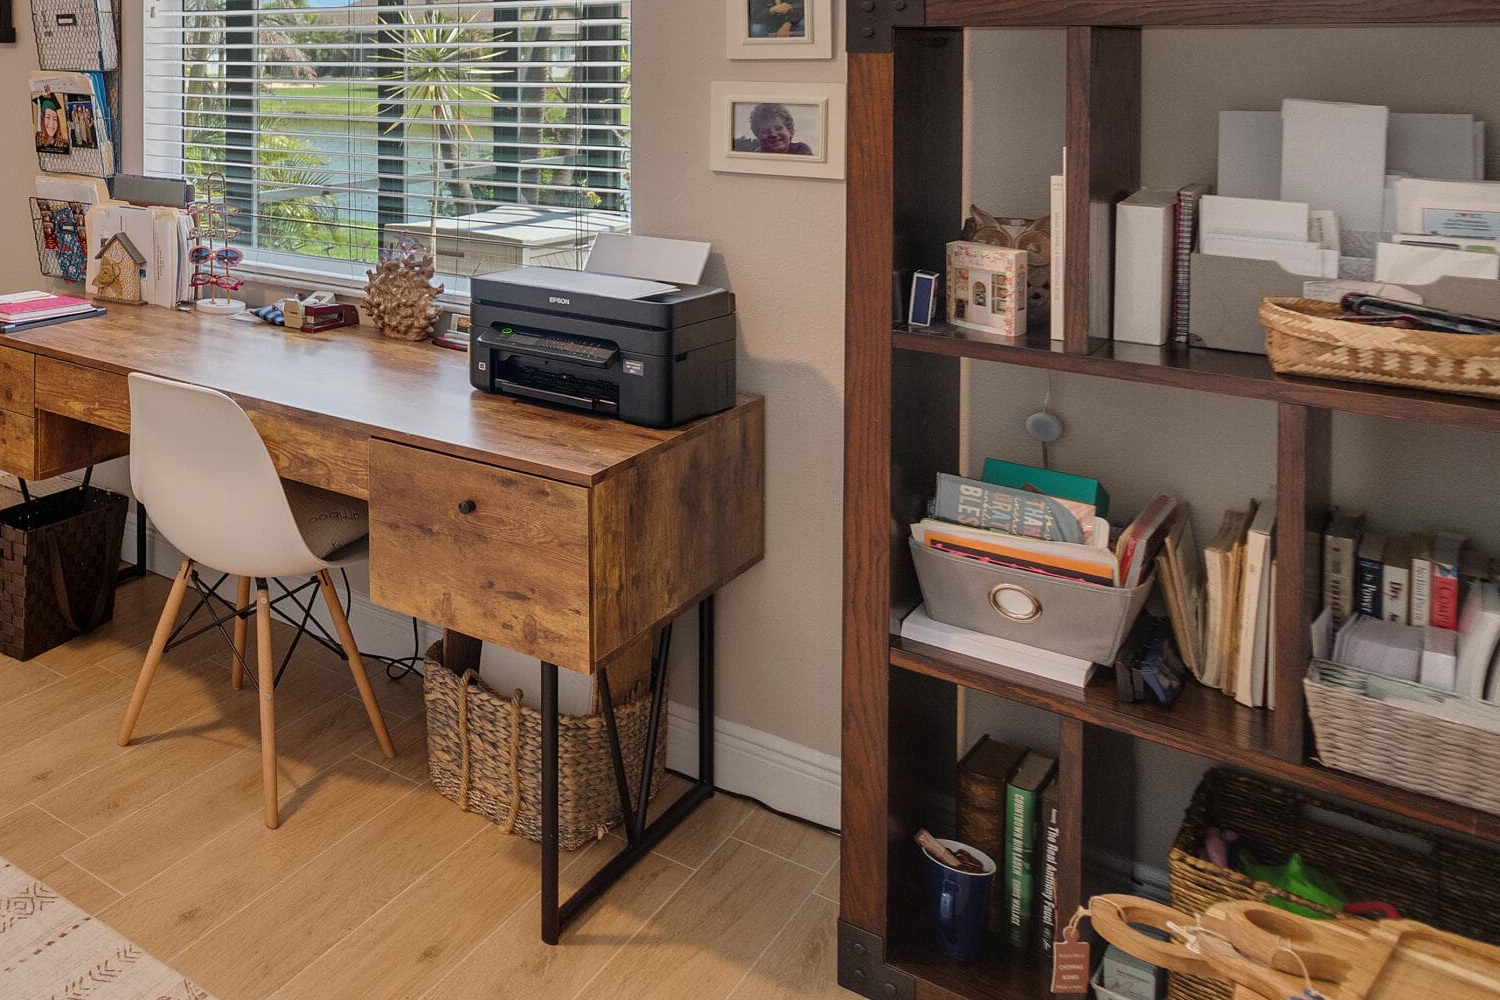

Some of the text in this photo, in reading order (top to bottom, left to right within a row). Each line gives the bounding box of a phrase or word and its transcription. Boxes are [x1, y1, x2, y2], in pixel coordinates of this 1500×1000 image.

[549, 296, 570, 305] EPSON
[1012, 793, 1025, 839] COUNTDOWN
[1012, 839, 1024, 853] BIN
[1047, 826, 1059, 843] The
[1011, 852, 1023, 877] LADEN
[1046, 843, 1058, 864] Real
[1041, 862, 1057, 900] Anthony
[1011, 897, 1021, 926] WALLACE
[1042, 900, 1055, 926] Fauci
